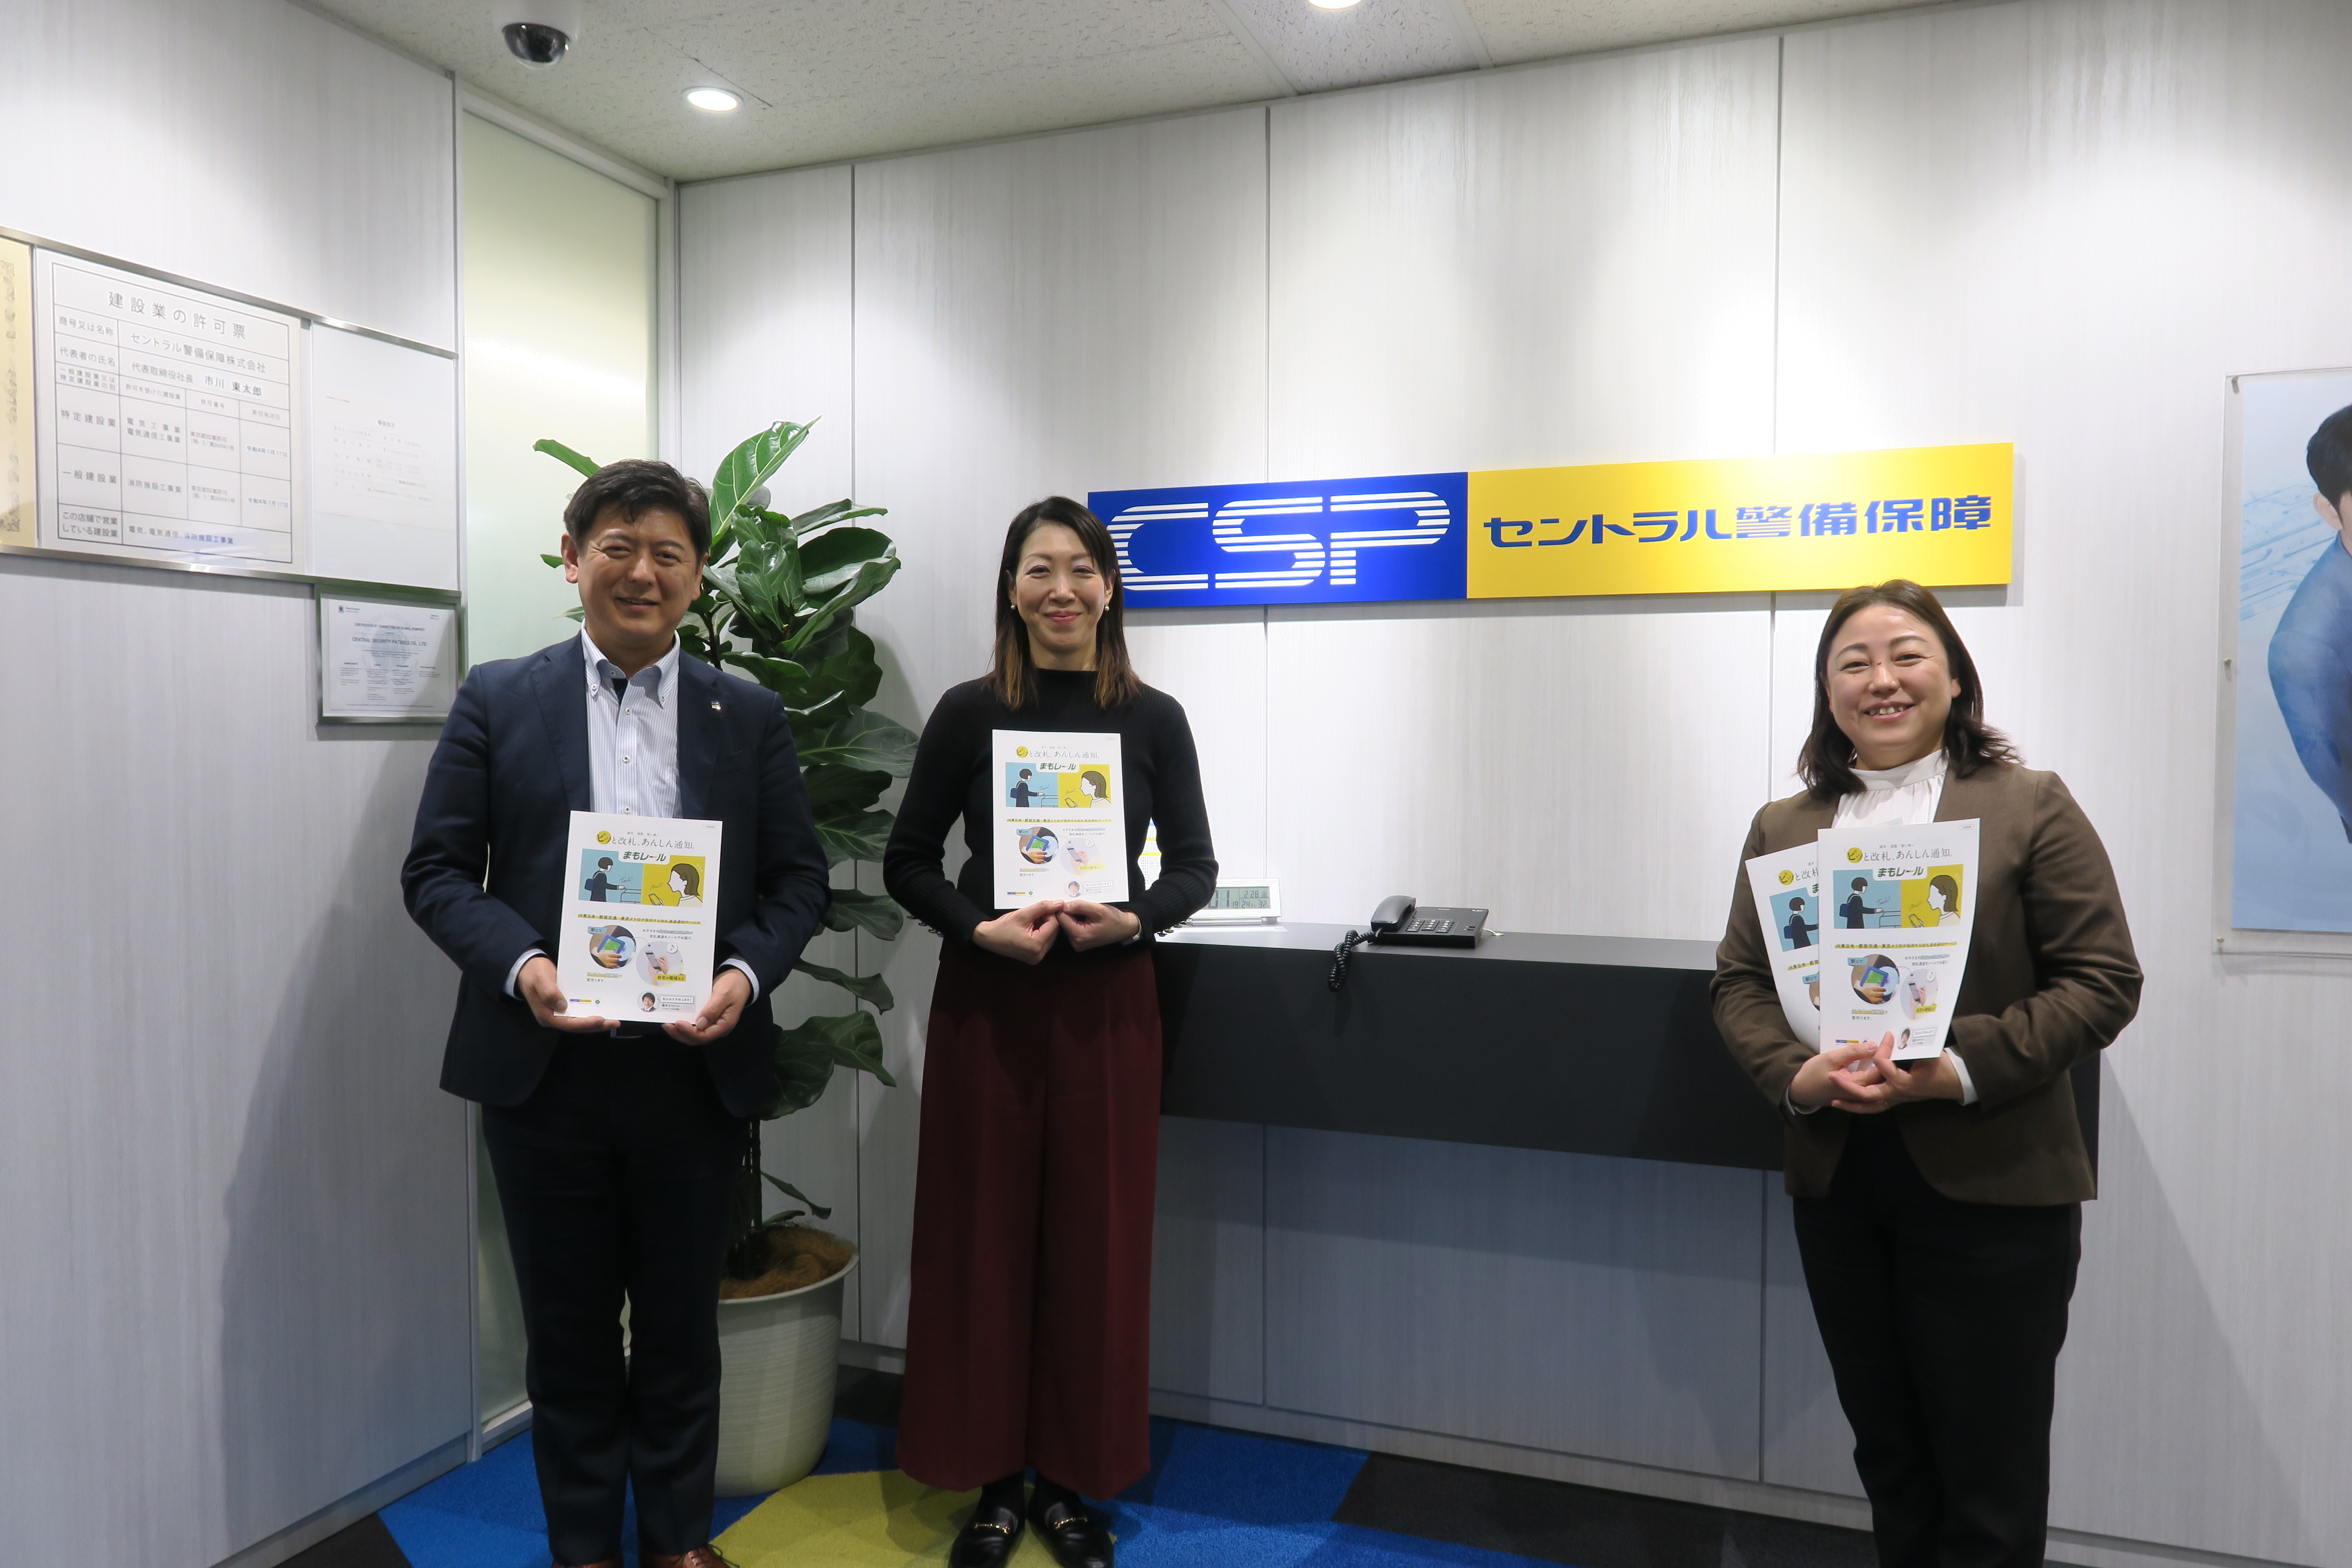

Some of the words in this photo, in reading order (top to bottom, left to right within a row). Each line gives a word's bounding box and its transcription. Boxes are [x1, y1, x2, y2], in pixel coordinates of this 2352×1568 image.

[108, 291, 245, 339] 建設業の許可票
[59, 316, 114, 337] 商号又は名称
[60, 346, 115, 367] 代表者の氏名
[131, 333, 266, 374] セントラル警備保障株式会社
[132, 362, 193, 384] 代表取締役社長
[205, 375, 224, 389] 市川
[232, 381, 262, 396] 東太郎
[63, 511, 118, 525] この店舗で営業
[1107, 491, 1451, 591] CSP
[1484, 495, 1992, 548] セントラル警備保障
[1017, 748, 1099, 759] ピッと改札、あんしん通知。
[597, 833, 695, 849] ピッと改札、あんしん通知。
[623, 851, 667, 861] まもレール
[1847, 848, 1952, 861] ピッと改札、あんしん通知。
[1878, 867, 1923, 877] まもレール
